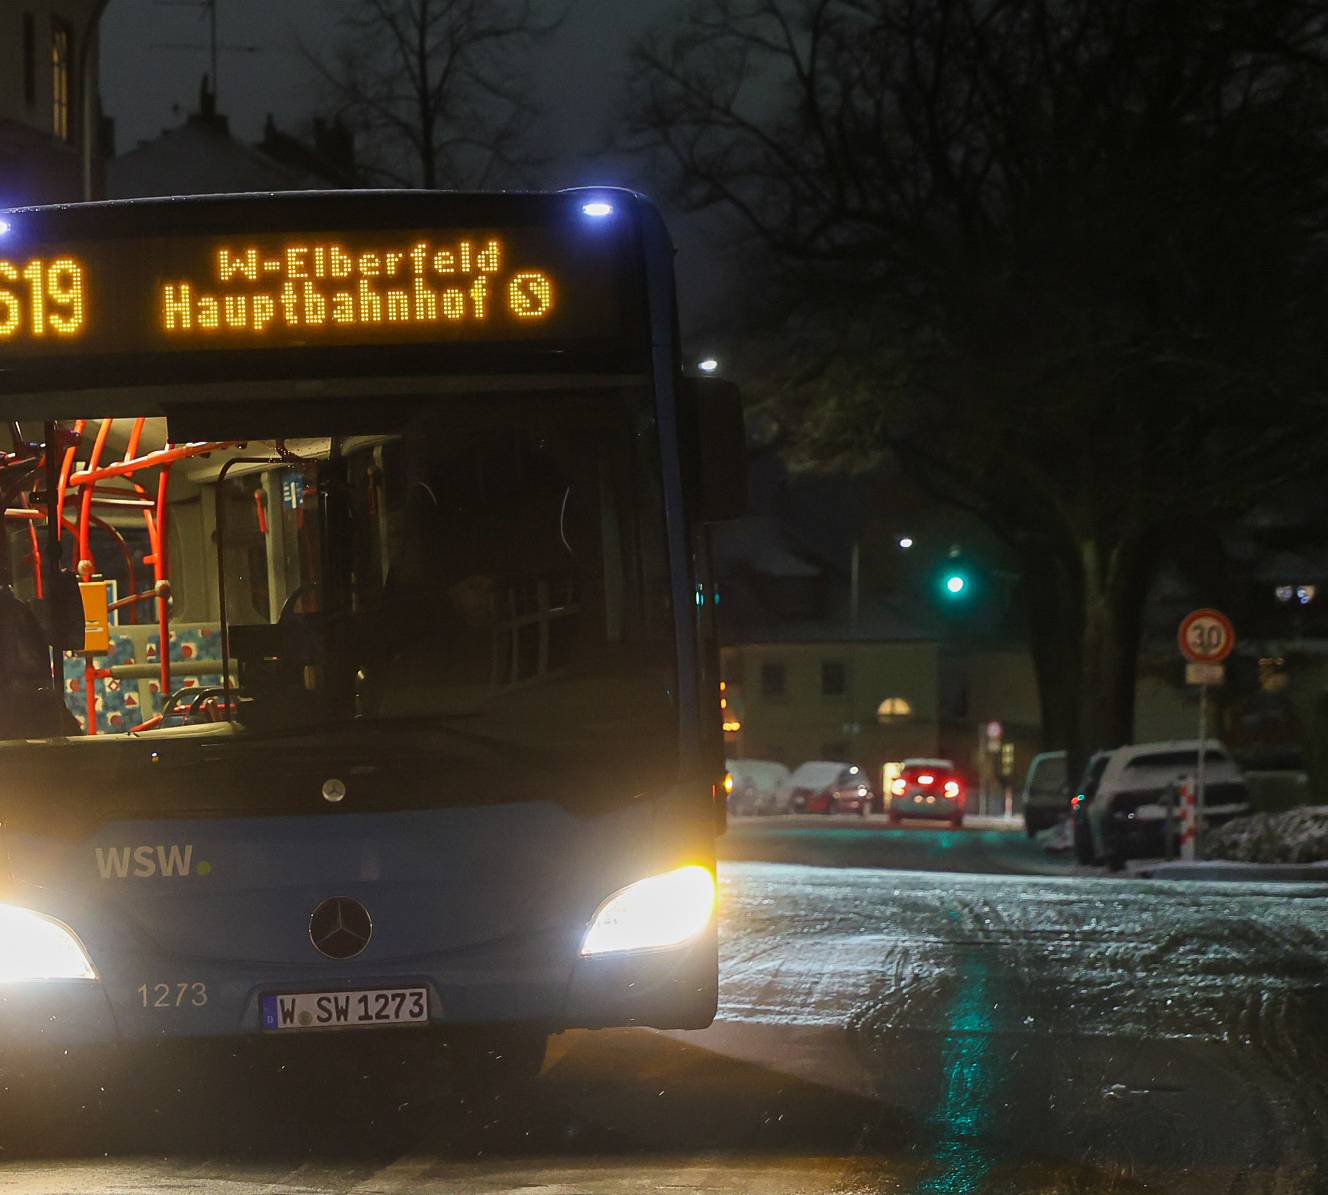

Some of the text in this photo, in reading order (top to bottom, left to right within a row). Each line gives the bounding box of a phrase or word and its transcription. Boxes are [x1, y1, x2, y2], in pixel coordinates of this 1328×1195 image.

[219, 242, 498, 281] W-Elberfeld
[165, 275, 487, 330] Hauptbahnhof
[1191, 623, 1223, 649] 30
[137, 982, 209, 1008] 1273
[279, 998, 296, 1025] W
[316, 995, 350, 1023] SW
[358, 992, 424, 1021] 1273
